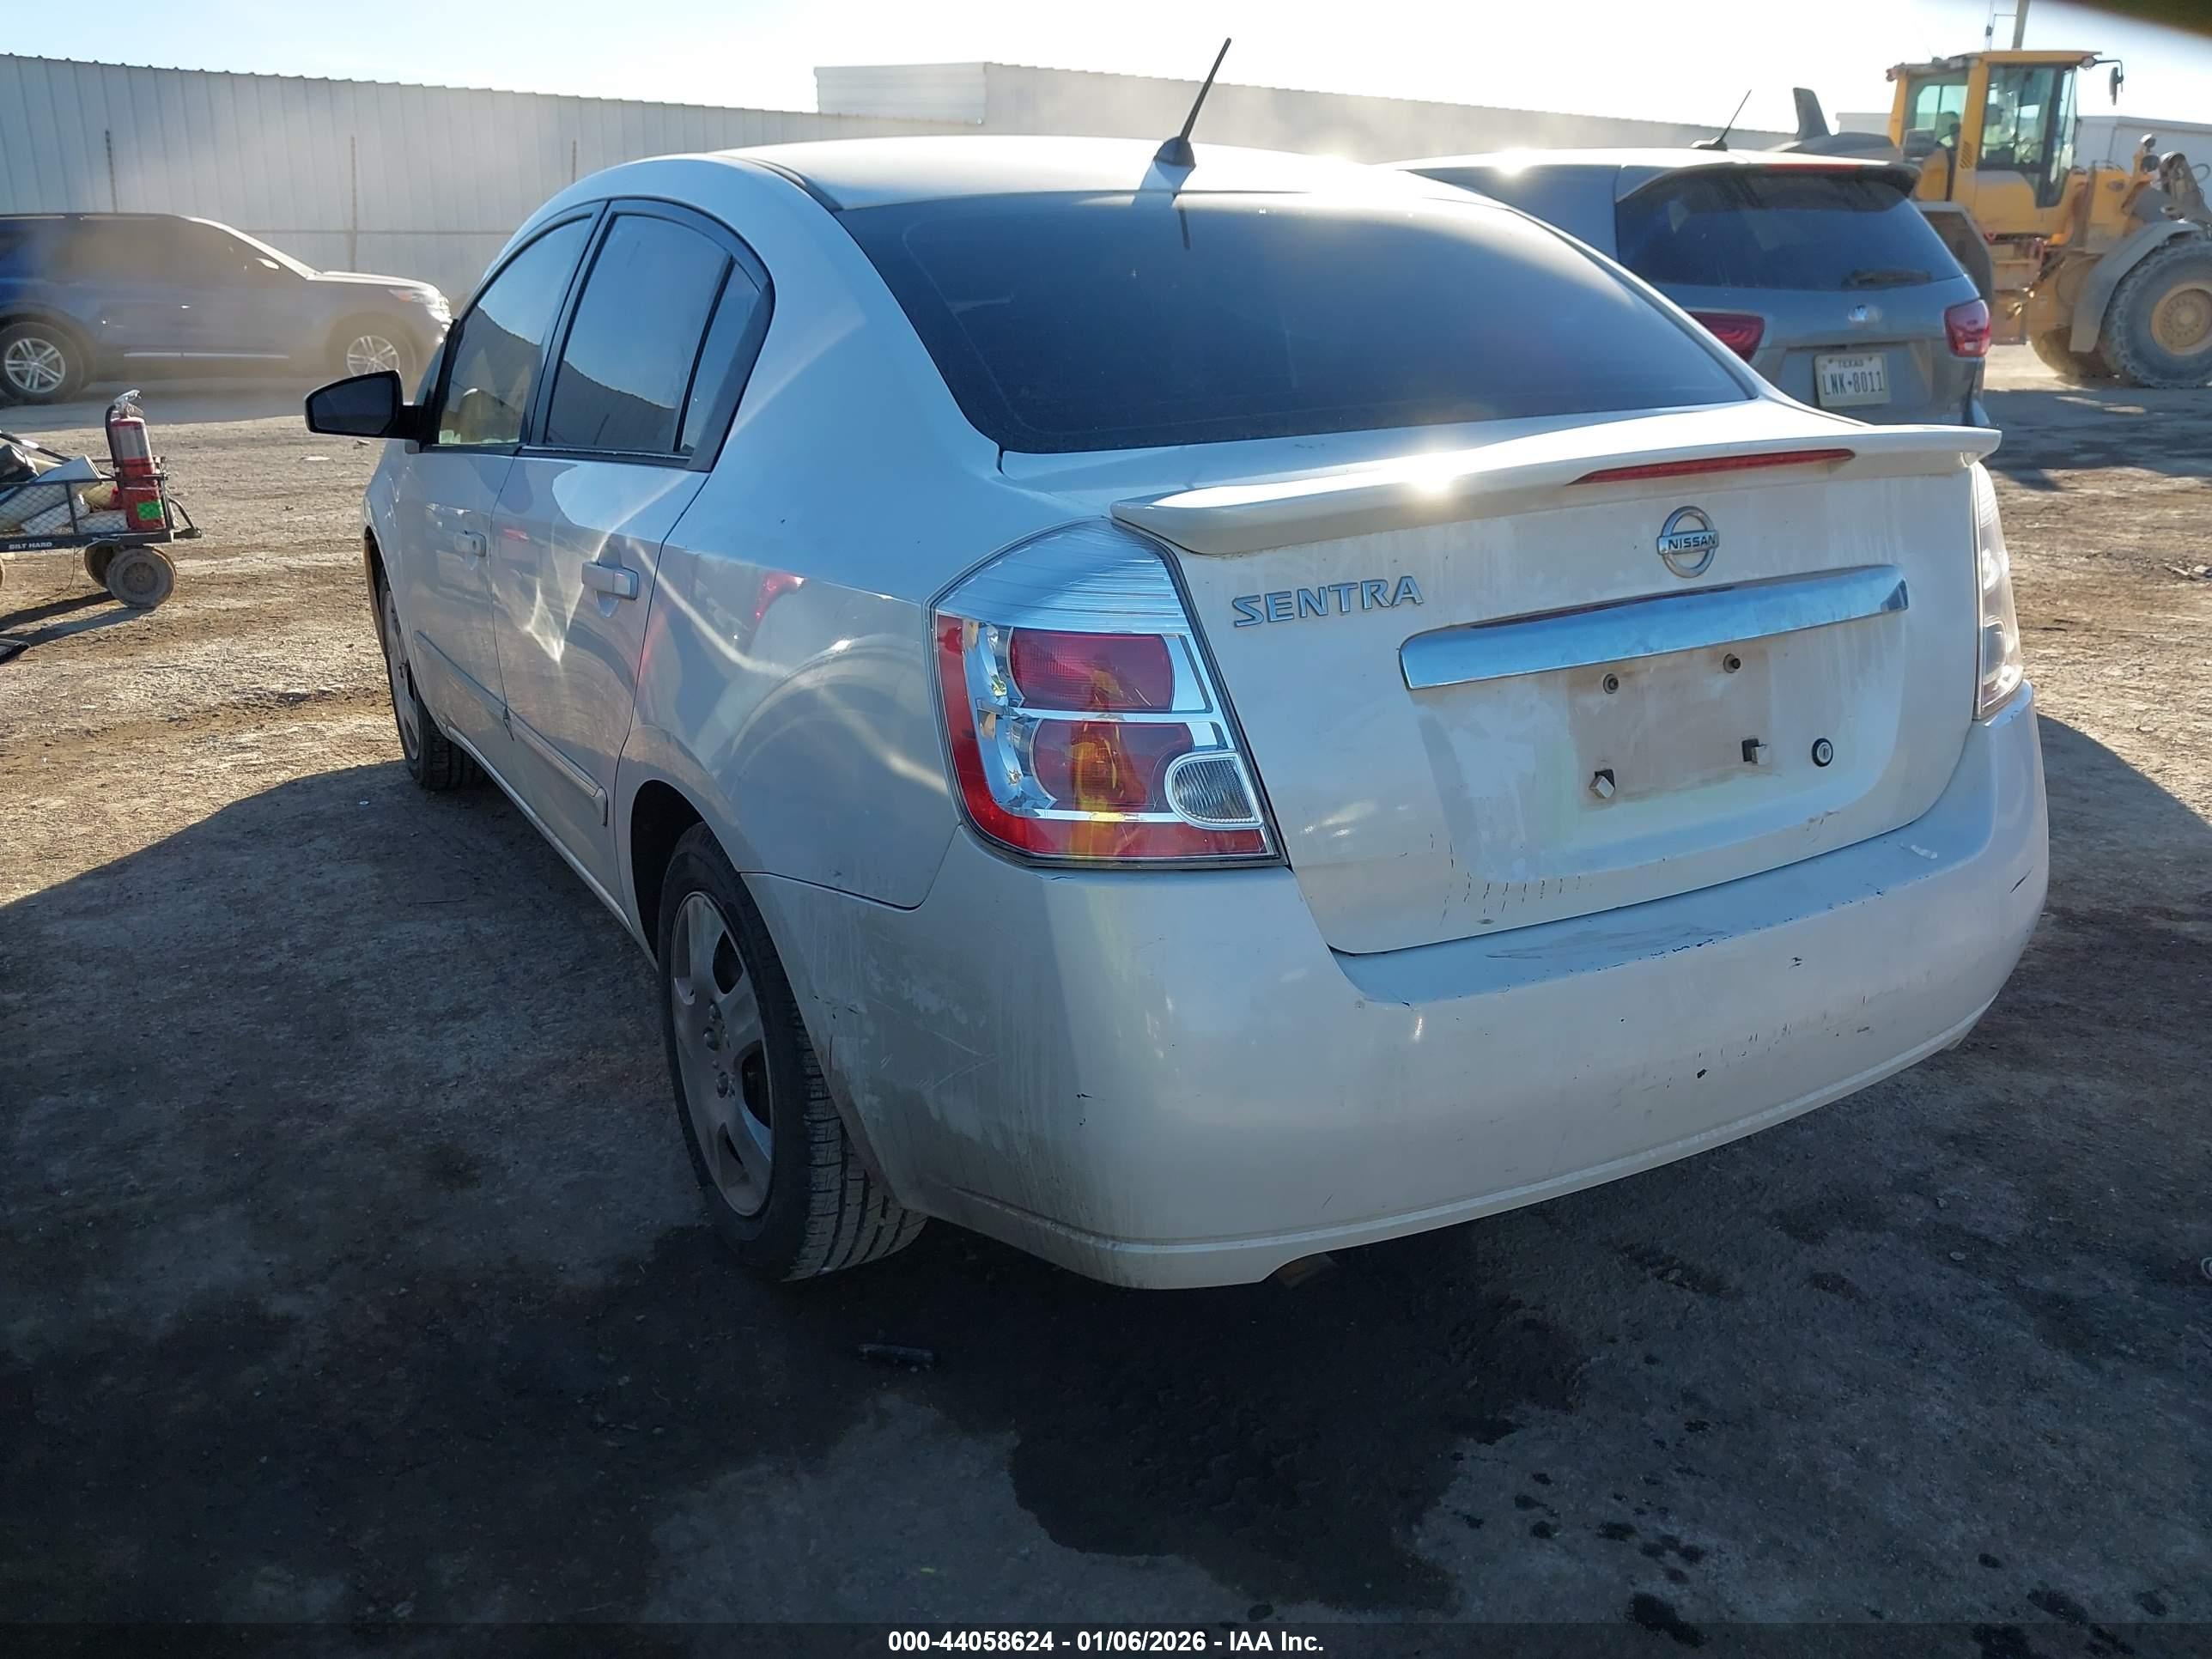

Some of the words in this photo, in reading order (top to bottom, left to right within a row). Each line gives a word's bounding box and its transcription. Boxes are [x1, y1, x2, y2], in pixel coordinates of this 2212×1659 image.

[1838, 358, 1864, 368] TEXAS
[1668, 535, 1716, 550] NISSAN
[1232, 574, 1425, 628] SENTRA
